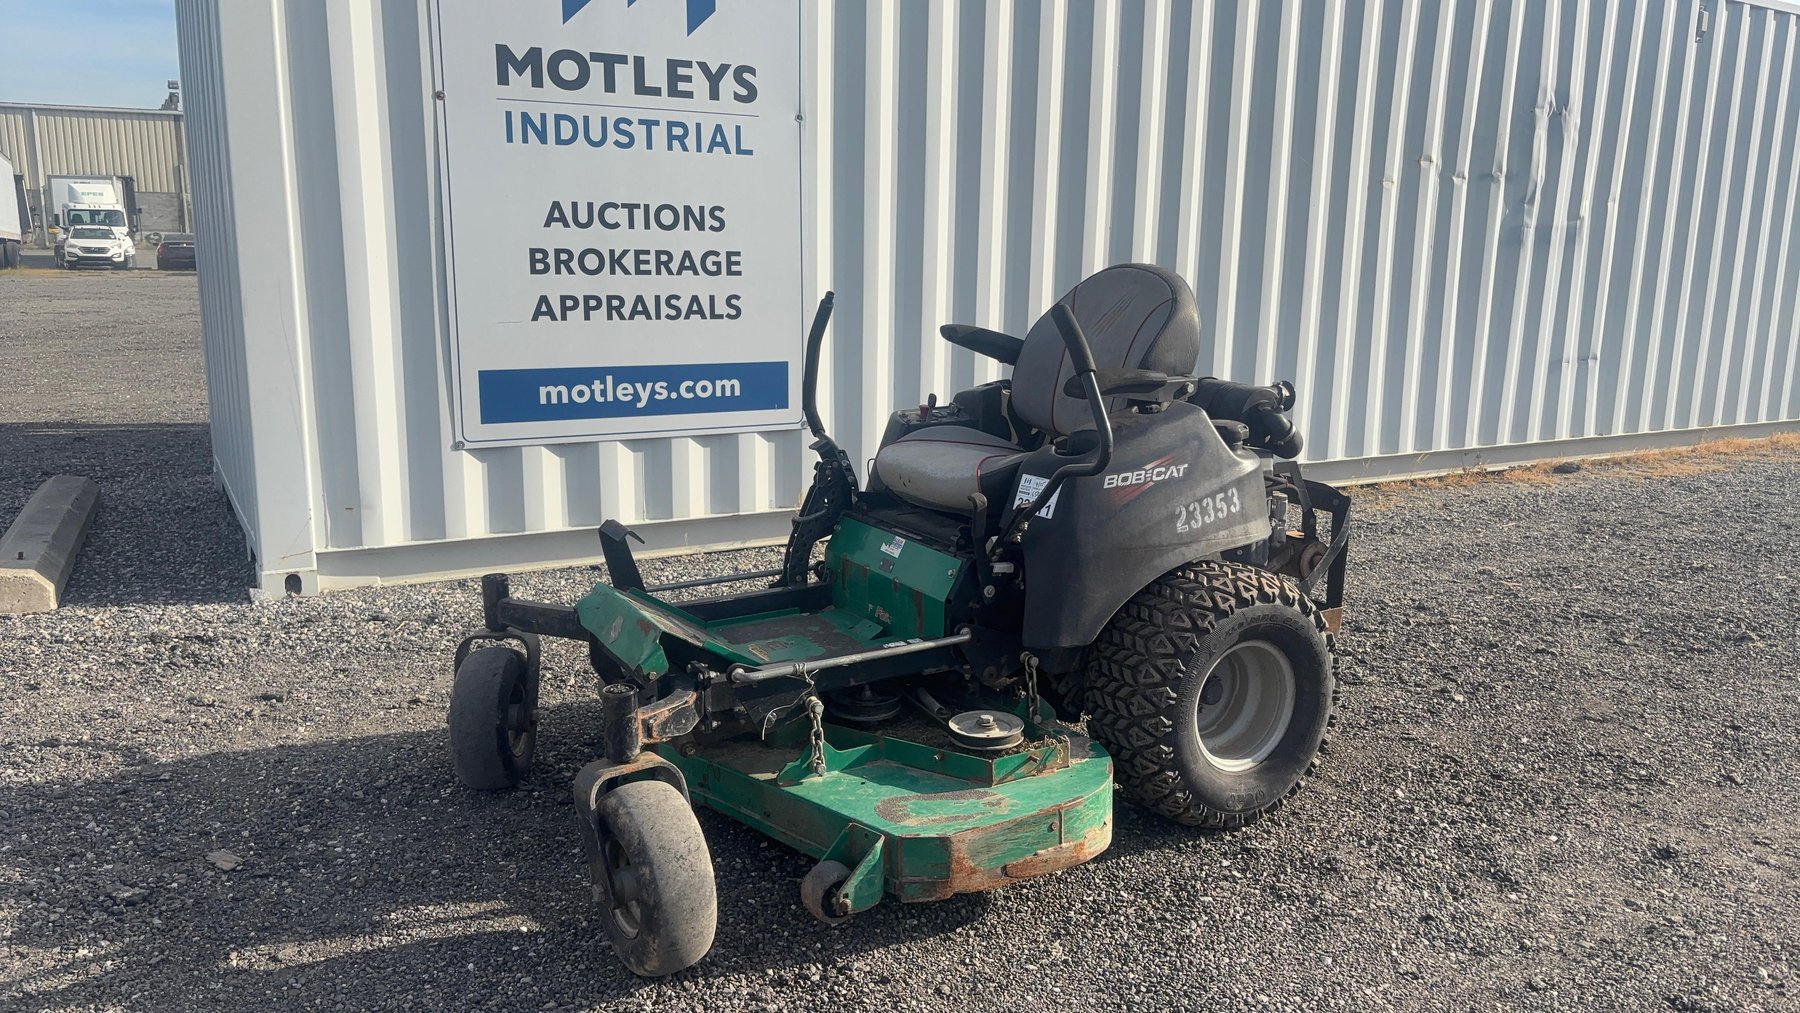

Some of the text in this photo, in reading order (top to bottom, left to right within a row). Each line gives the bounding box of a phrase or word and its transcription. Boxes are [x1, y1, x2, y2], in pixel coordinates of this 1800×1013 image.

[495, 43, 759, 104] MOTLEYS
[504, 110, 754, 156] INDUSTRIAL
[543, 200, 726, 233] AUCTIONS
[528, 247, 743, 277] BROKERAGE
[530, 293, 743, 322] APPRAISALS
[539, 375, 741, 409] motleys.com
[1175, 487, 1241, 533] 23353
